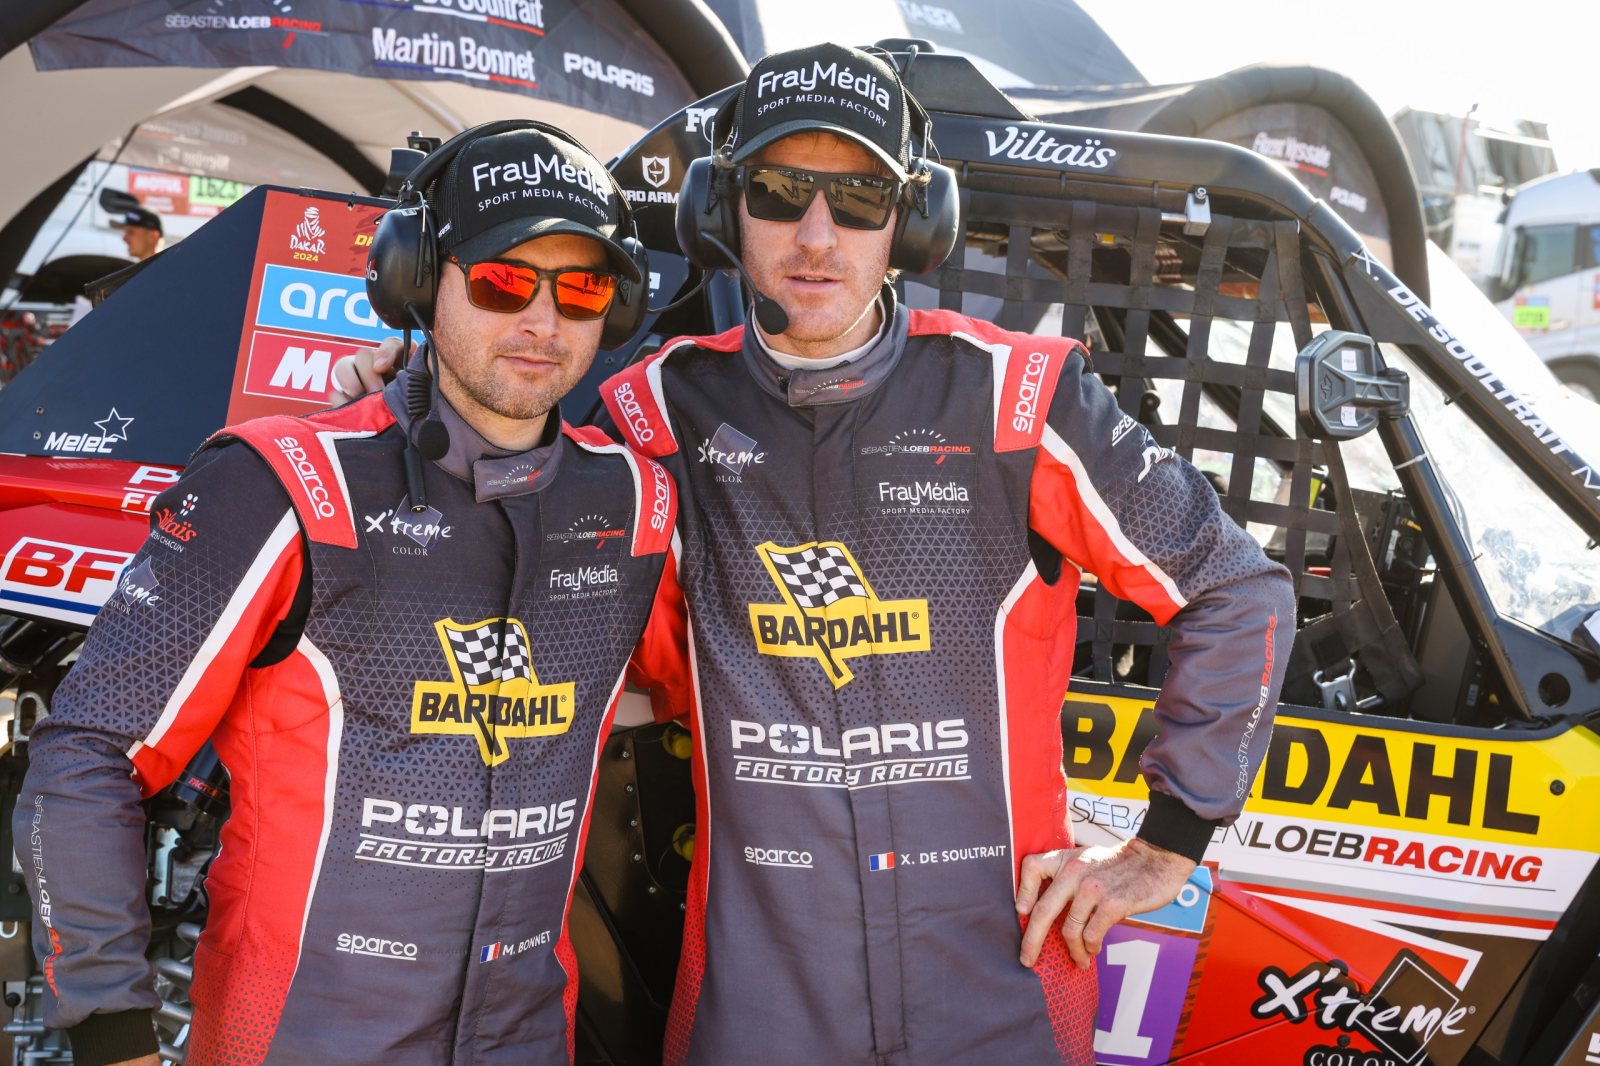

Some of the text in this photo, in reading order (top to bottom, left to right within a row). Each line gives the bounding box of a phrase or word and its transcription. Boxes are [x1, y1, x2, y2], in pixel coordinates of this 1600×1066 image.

[372, 27, 536, 81] Martin Bonnet
[564, 52, 655, 96] POLARIS
[758, 61, 890, 111] FrayMédia
[686, 107, 720, 132] FO
[757, 94, 887, 127] SPORT MEDIA FACTORY
[985, 126, 1117, 169] Viltaïs
[472, 153, 609, 205] FrayMédia
[478, 188, 609, 222] SPORT MEDIA FACTORY
[647, 191, 679, 204] ARM
[290, 234, 326, 255] DAKAR
[293, 252, 319, 262] 2024
[1012, 352, 1050, 435] sparco
[1428, 326, 1575, 456] SOULTRAIT
[614, 382, 654, 447] sparco
[44, 432, 118, 453] Melec
[275, 436, 335, 520] sparco
[878, 481, 969, 506] FrayMédia
[881, 507, 971, 516] SPORT MEDIA FACTORY
[392, 546, 429, 557] COLOR
[550, 565, 619, 592] FrayMédia
[550, 593, 570, 601] SPORT
[571, 591, 590, 600] MEDIA
[757, 611, 921, 650] BARDAHL
[418, 692, 568, 728] BARDAHL
[730, 718, 969, 759] POLARIS
[734, 759, 969, 786] FACTORY RACING
[1060, 698, 1540, 835] BADAHL
[361, 797, 577, 839] POLARIS
[355, 837, 567, 867] FACTORY RACING
[744, 846, 813, 869] sparco
[900, 845, 1007, 866] X. DE SOULTRAIT
[336, 931, 418, 960] sparco
[502, 930, 552, 957] M. BONNET
